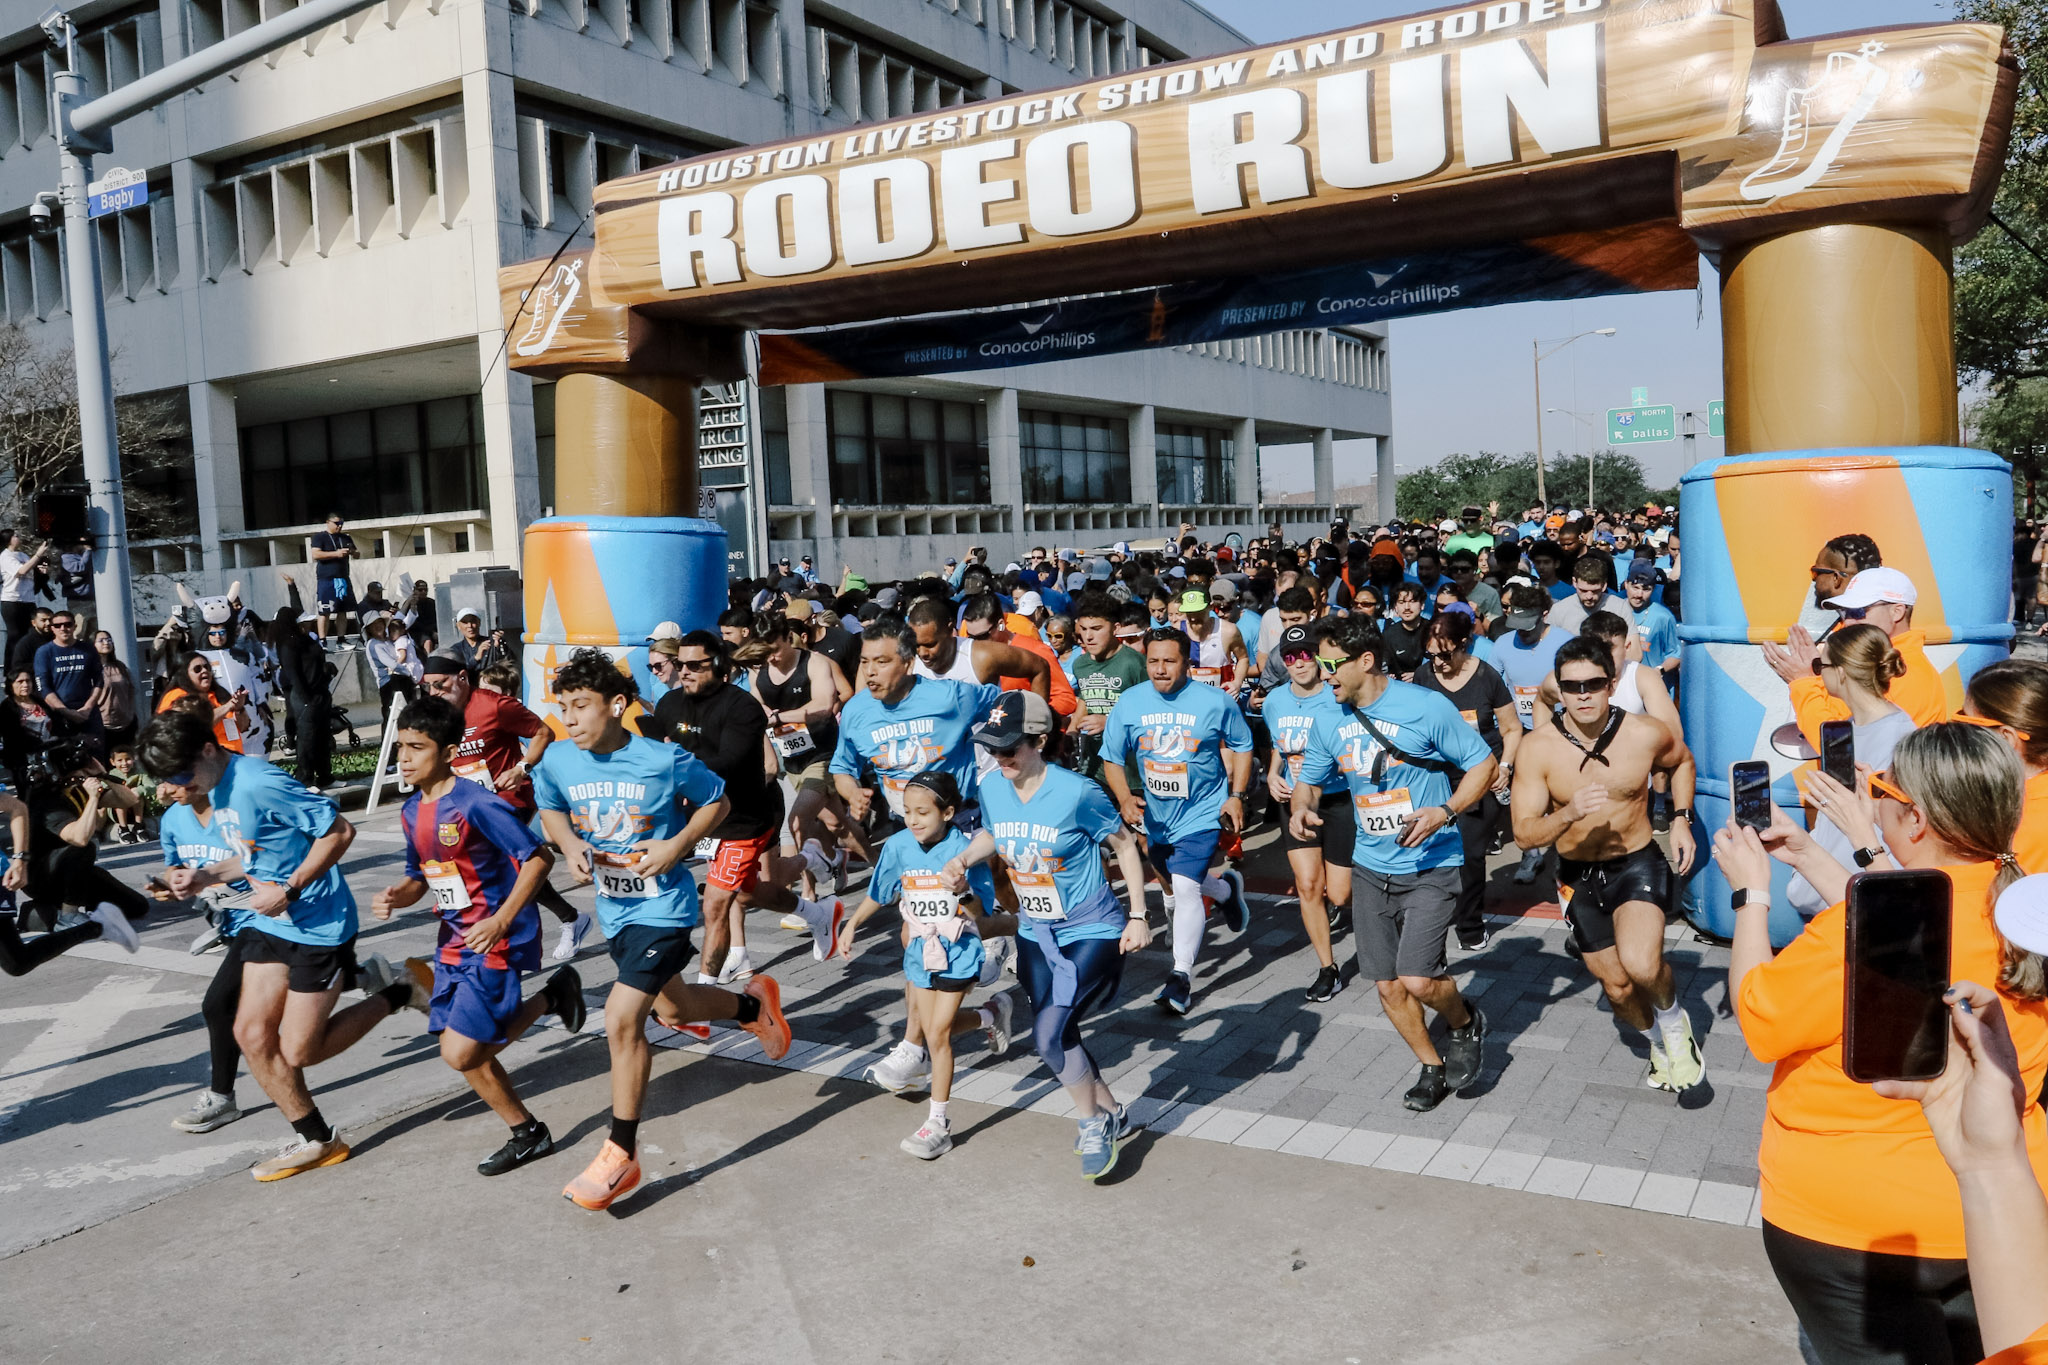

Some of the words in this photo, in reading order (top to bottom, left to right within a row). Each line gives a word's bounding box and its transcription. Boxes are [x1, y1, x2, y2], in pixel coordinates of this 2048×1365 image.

[657, 140, 831, 192] HOUSTON
[844, 93, 1082, 159] LIVESTOCK
[1098, 59, 1250, 112] SHOW
[1266, 32, 1379, 77] AND
[658, 120, 1138, 290] RODEO
[1188, 22, 1603, 215] RUN
[108, 169, 123, 179] CIVIC
[132, 171, 145, 182] 900
[104, 178, 129, 190] DISTRICT
[101, 189, 134, 210] Bagby
[1317, 284, 1461, 314] ConocoPhillips
[1221, 302, 1287, 325] PRESENTED
[1290, 301, 1306, 316] BY
[979, 332, 1096, 357] ConocoPhillips
[904, 347, 953, 363] PRESENTED
[956, 347, 968, 358] BY
[702, 408, 739, 425] ATER
[1619, 415, 1632, 424] 45
[1632, 428, 1669, 438] Dallas
[1141, 712, 1174, 727] RODEO
[1176, 712, 1197, 727] RUN
[1278, 715, 1303, 729] RODEO
[871, 722, 908, 744] RODEO
[909, 719, 934, 734] RUN
[1374, 719, 1399, 738] RUN
[458, 738, 486, 752] CATS
[783, 736, 806, 750] 4863
[568, 781, 613, 801] RODEO
[617, 781, 646, 800] RUN
[1148, 777, 1180, 792] 6090
[1367, 814, 1403, 831] 2214
[993, 821, 1029, 840] RODEO
[1031, 823, 1059, 844] RUN
[695, 839, 714, 850] 88
[604, 875, 645, 893] 4730
[910, 899, 950, 917] 2293
